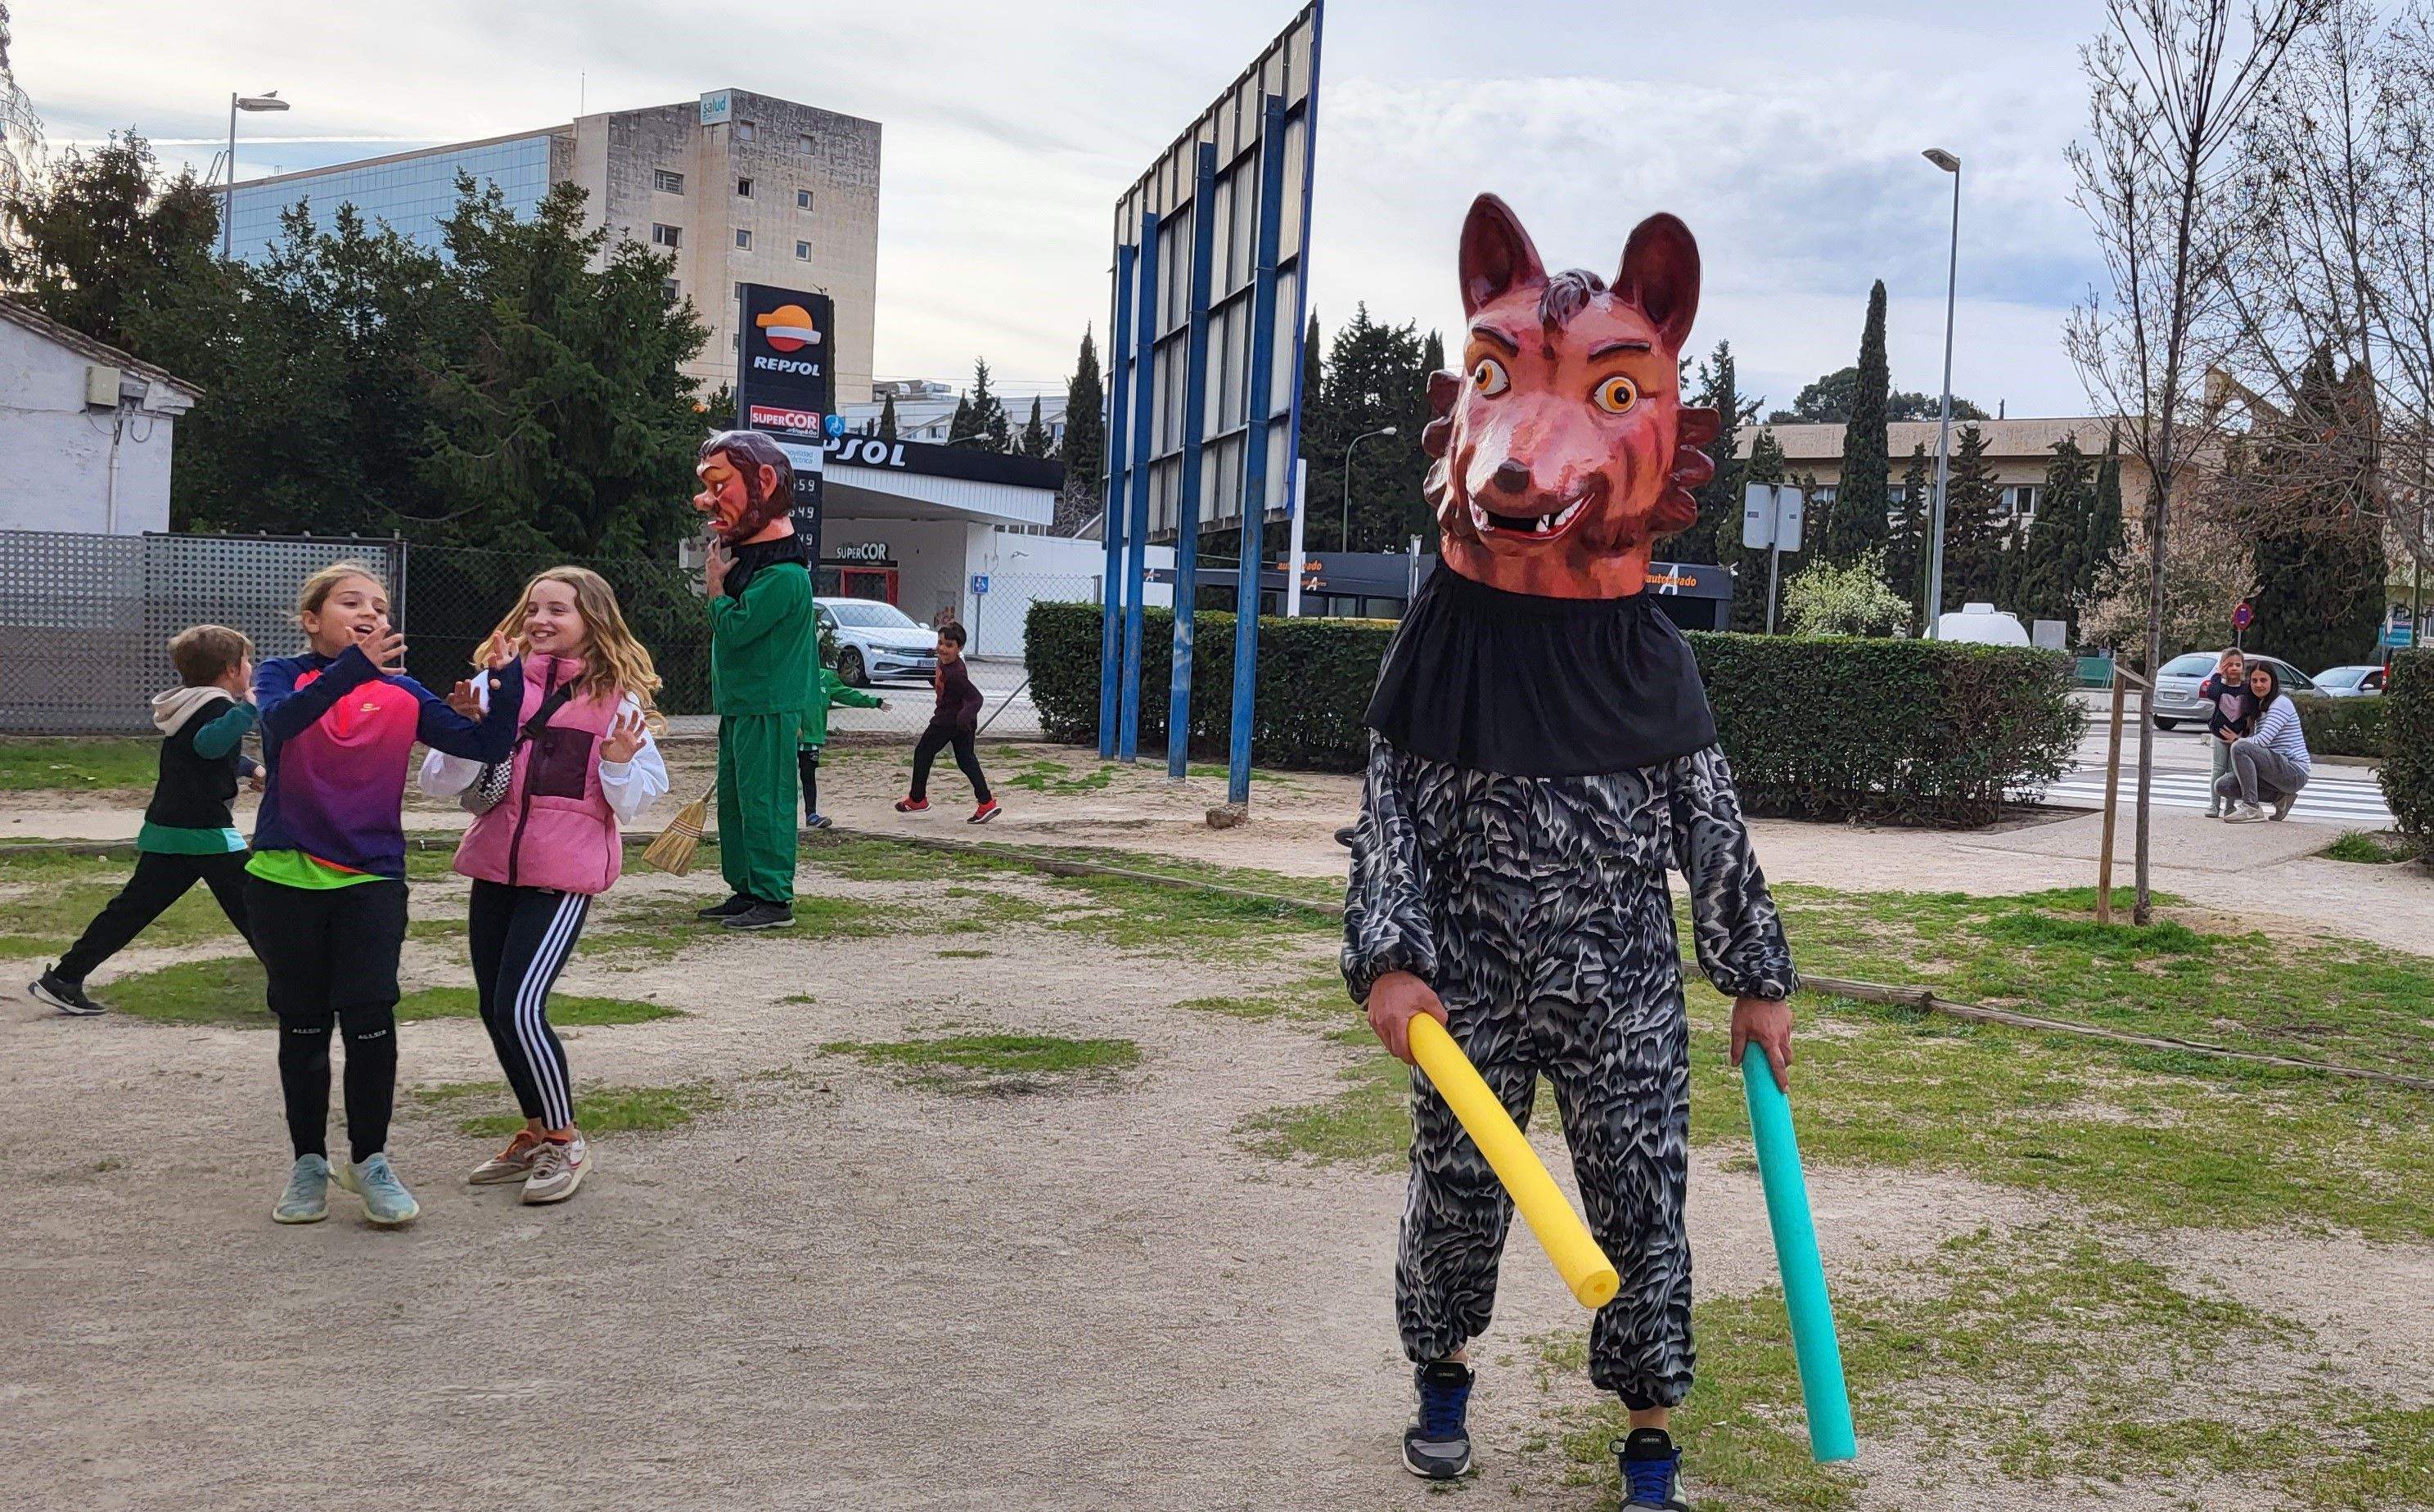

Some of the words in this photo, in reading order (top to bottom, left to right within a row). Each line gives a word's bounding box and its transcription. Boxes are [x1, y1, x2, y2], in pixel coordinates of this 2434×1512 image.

[702, 95, 726, 115] salud
[753, 355, 820, 376] REPSOL
[752, 412, 817, 430] SUPERCOR
[794, 479, 815, 492] 59
[836, 542, 886, 560] SUPERCOR
